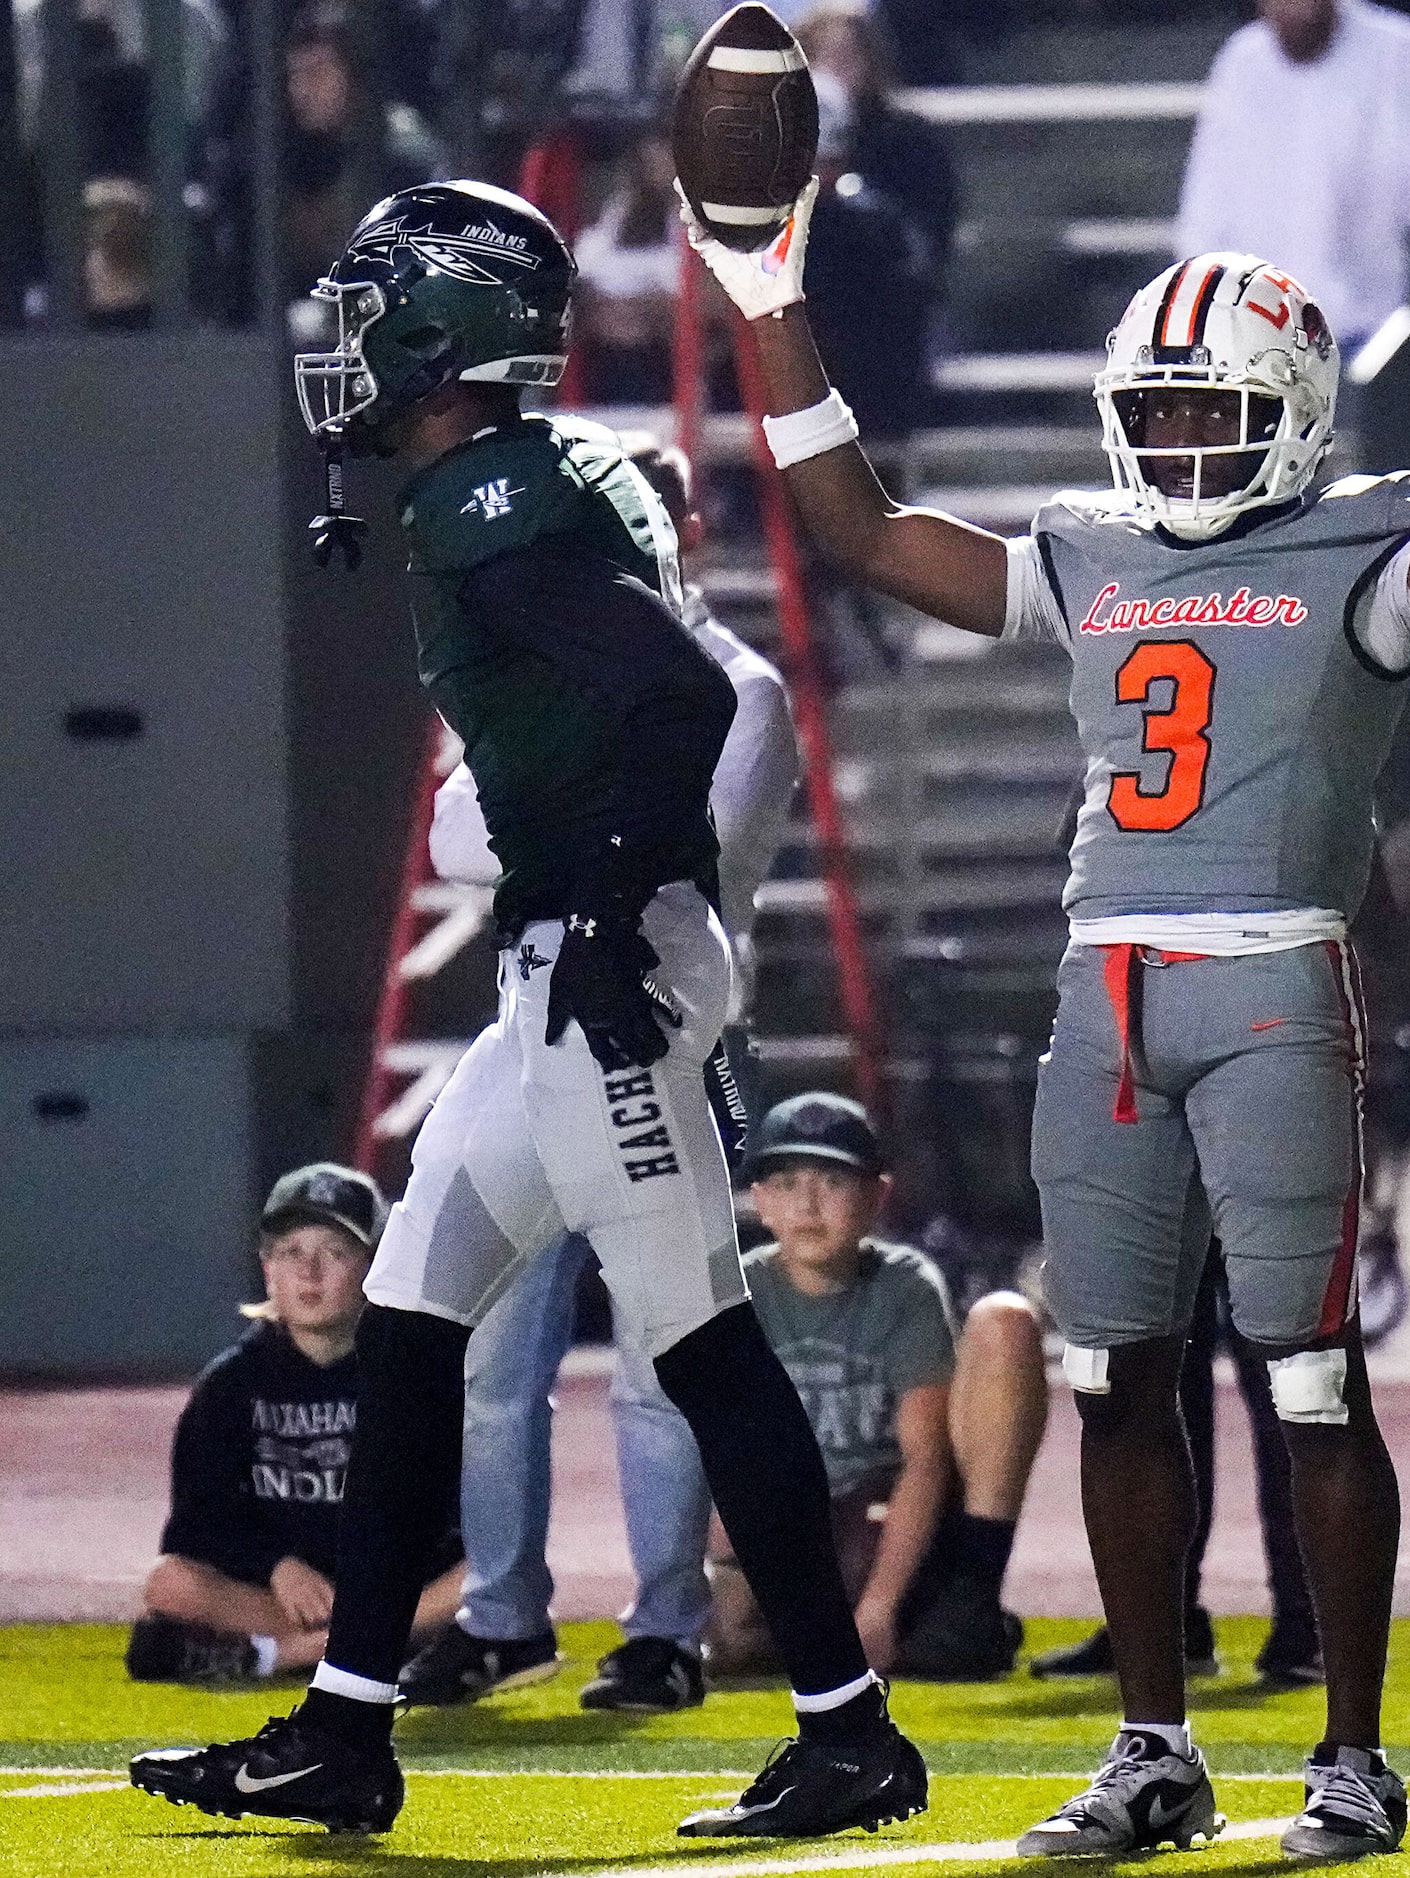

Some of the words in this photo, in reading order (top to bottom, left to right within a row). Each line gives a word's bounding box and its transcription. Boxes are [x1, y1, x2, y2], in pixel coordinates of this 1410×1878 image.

[460, 223, 528, 250] INDIANS
[328, 463, 344, 509] NXTRND
[1079, 582, 1309, 636] Lancaster
[1106, 638, 1218, 833] 3
